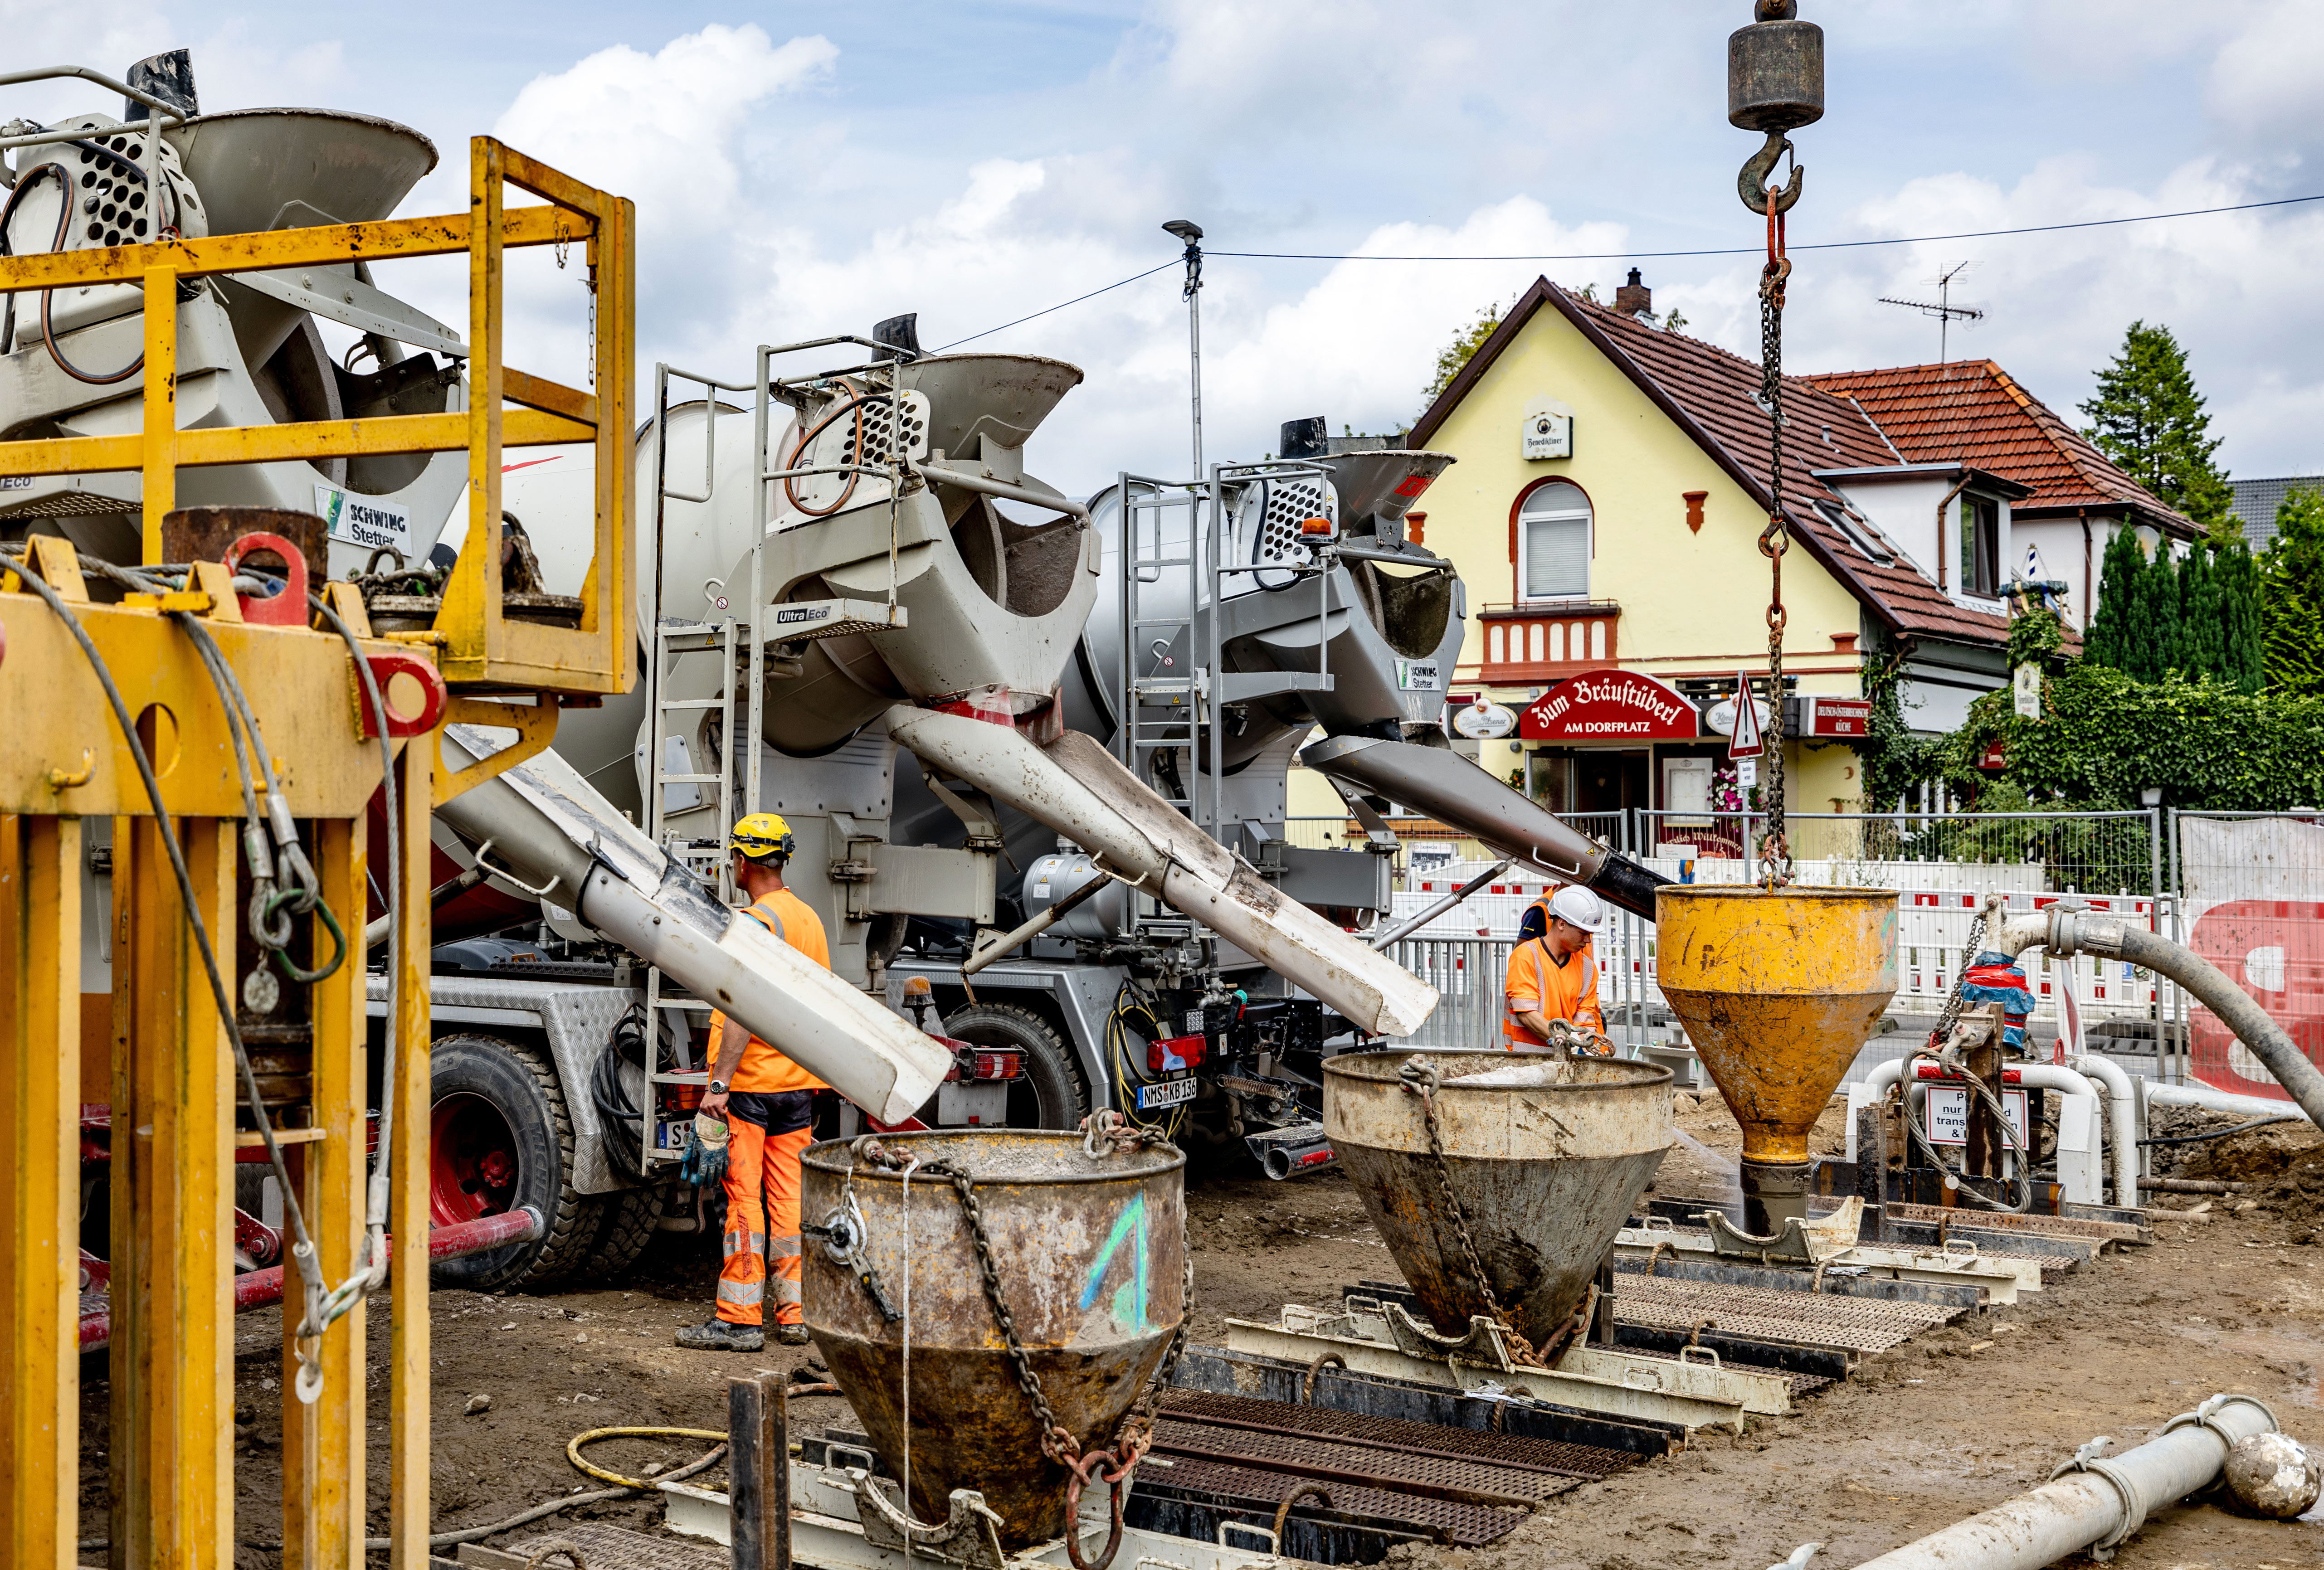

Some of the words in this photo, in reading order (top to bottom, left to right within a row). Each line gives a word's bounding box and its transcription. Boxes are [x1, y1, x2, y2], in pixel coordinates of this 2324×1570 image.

[1527, 437, 1563, 448] Benediktiner
[351, 504, 406, 533] SCHWING
[352, 523, 395, 546] Stetter
[780, 612, 805, 622] Ultra
[809, 609, 827, 619] Eco
[1411, 666, 1437, 677] SCHWING
[1413, 677, 1432, 688] Stetter
[1531, 695, 1570, 728] Zum
[1481, 715, 1506, 725] Pilsener
[1835, 719, 1851, 732] KÜCHE
[1564, 723, 1583, 733] AM
[1586, 722, 1651, 733] DORFPLATZ
[1661, 834, 1690, 845] erzlich
[1693, 831, 1743, 852] Willkommen
[1145, 1086, 1163, 1105] NMS
[1169, 1083, 1180, 1101] KB
[1182, 1079, 1196, 1099] 136
[1943, 1106, 1962, 1114] nur
[672, 1124, 682, 1146] S
[1952, 1129, 1960, 1137] &
